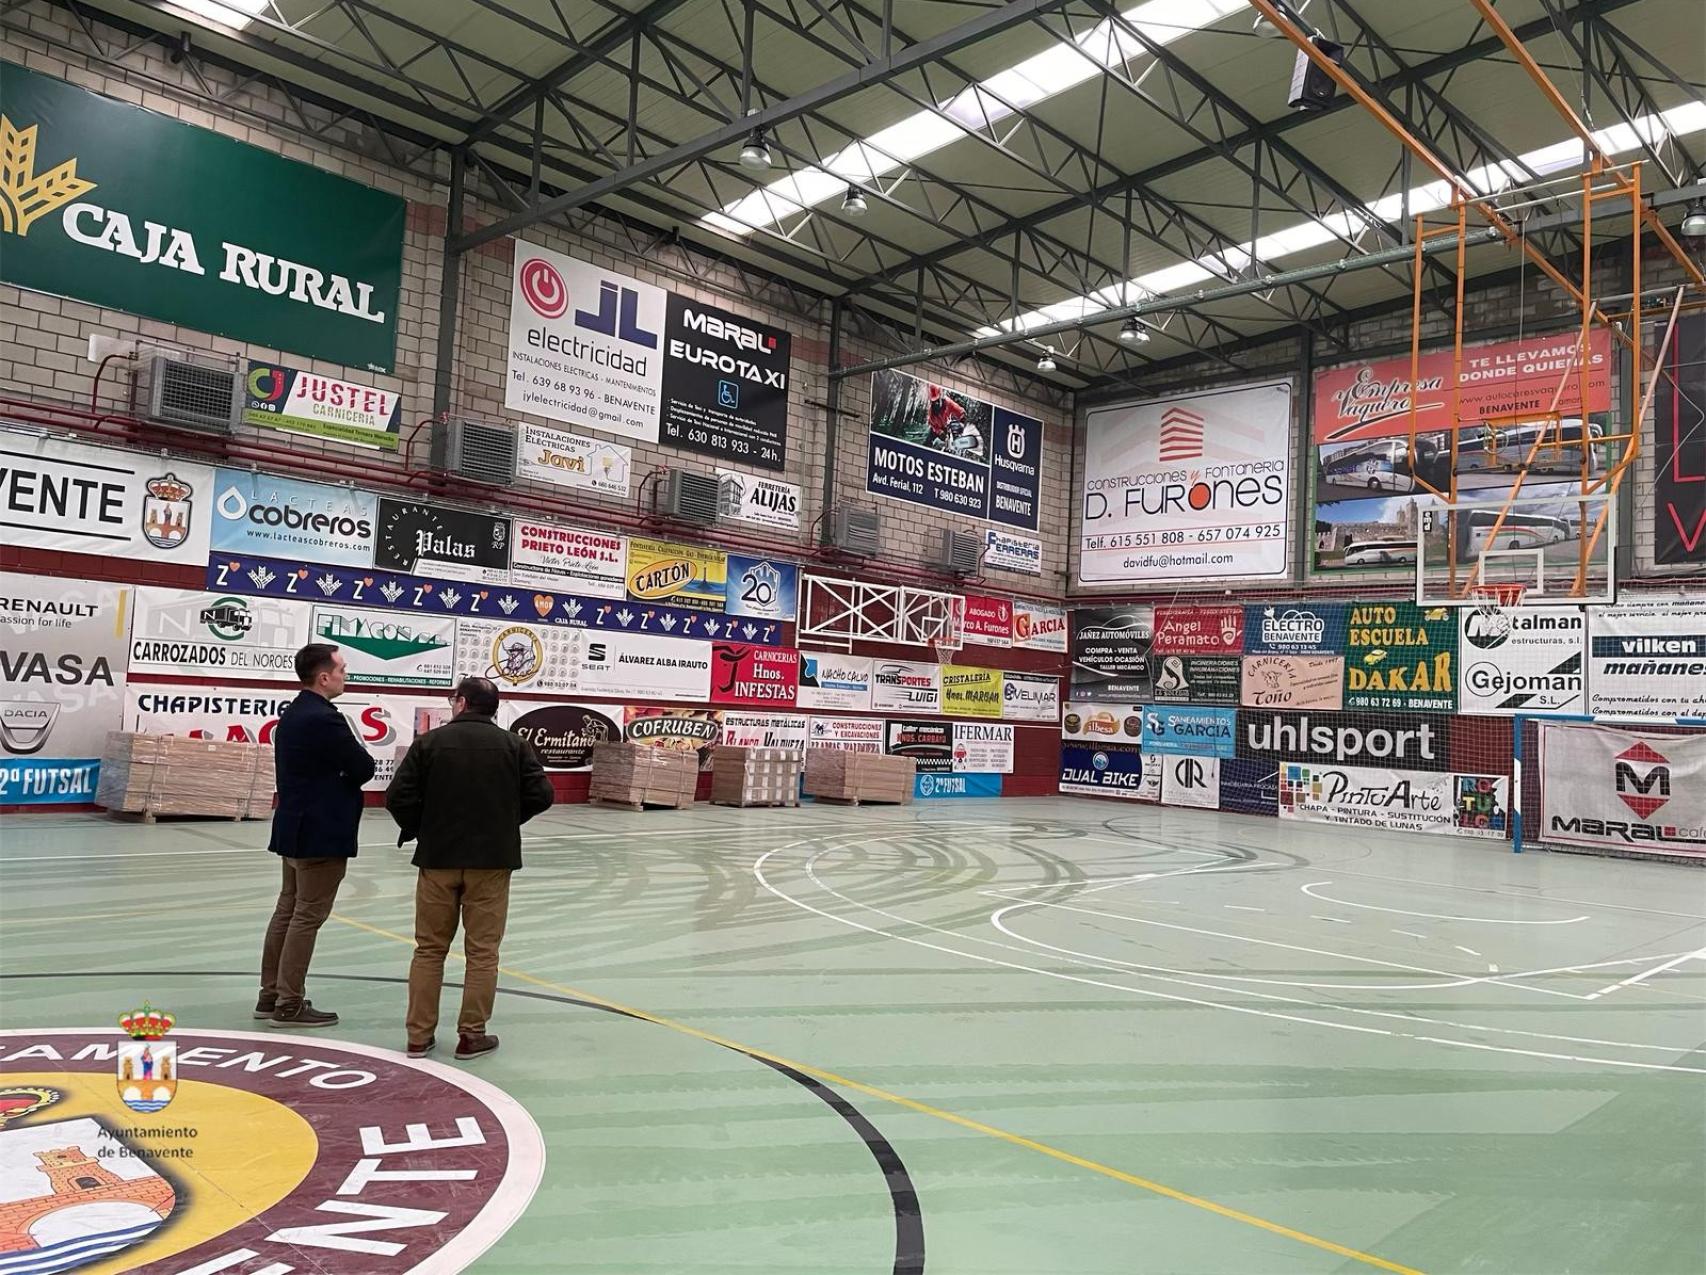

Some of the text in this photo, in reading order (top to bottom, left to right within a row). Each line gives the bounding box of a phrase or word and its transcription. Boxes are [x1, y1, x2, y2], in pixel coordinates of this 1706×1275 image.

[63, 203, 385, 324] CAJA RURAL
[512, 351, 562, 372] INSTALACIONES
[528, 327, 647, 377] electricidad
[670, 339, 786, 390] EUROTAXI
[1469, 357, 1490, 368] TE
[1350, 366, 1444, 403] Emprsa
[1459, 367, 1517, 383] DONDE
[297, 376, 390, 416] JUSTEL
[532, 375, 656, 415] 639 68 93 96 BENAVENTE
[1479, 400, 1541, 415] BENAVENTE
[666, 422, 684, 438] Tel.
[688, 428, 708, 444] 630
[711, 434, 727, 449] 813
[731, 439, 749, 454] 933
[538, 449, 585, 473] Javi
[874, 446, 924, 478] MOTOS
[872, 472, 889, 486] Avd.
[912, 482, 924, 495] 112
[927, 461, 985, 494] ESTEBAN
[750, 488, 797, 512] ALIJAS
[969, 496, 982, 509] 923
[995, 494, 1032, 516] BENAVENTE
[1085, 493, 1113, 520] D.
[249, 504, 372, 539] cobreros
[246, 529, 371, 552] www.lacteascobreros.com
[415, 529, 476, 559] Palas
[521, 526, 622, 551] CONSTRUCCIONES
[1086, 524, 1280, 550] Telf. 615 551 808 657 074 925
[521, 539, 564, 554] PRIETO
[566, 545, 597, 559] LEÓN
[1123, 552, 1234, 569] davidfu@hotmail.com
[635, 561, 691, 592] CARTÓN
[741, 573, 772, 604] 20
[38, 616, 72, 629] for life
[953, 617, 975, 630] Mrco
[1163, 615, 1201, 635] Ángel
[1263, 619, 1323, 632] ELECTRO
[1350, 607, 1396, 625] AUTO
[1078, 629, 1150, 641] JAÑEZ AUTOMÓVILES
[1156, 631, 1220, 646] Peramato
[1264, 632, 1320, 641] BENAVENTE
[1350, 628, 1429, 646] ESCUELA
[133, 641, 248, 667] CARROZADOS DEL
[1622, 639, 1697, 653] vilken
[618, 651, 708, 670] ÁLVAREZ ALBA IRAUTO
[753, 650, 797, 664] CARNICERIAS
[1079, 655, 1113, 663] VEHÍCULOS
[581, 663, 611, 671] SEAT
[752, 662, 785, 680] Hnos.
[1349, 651, 1453, 692] DAKAR
[875, 673, 932, 687] TRANSPORTES
[1472, 670, 1581, 694] Gejoman
[735, 681, 796, 701] INFESTAS
[908, 691, 938, 704] LUIGI
[1252, 689, 1293, 705] Toño
[1539, 695, 1560, 705] S.L.
[1592, 693, 1659, 705] Comprometidos
[1355, 697, 1453, 709] 980 63 72 69 BENAVENTE
[1592, 706, 1659, 716] Comprometidos
[1680, 708, 1689, 717] el
[4, 708, 48, 719] DACIA
[725, 717, 806, 729] ESTRUCTURAS METÁLICAS
[1168, 715, 1232, 727] SANEAMIENTOS
[632, 719, 715, 739] COFRUBEN
[832, 722, 882, 731] CONSTRUCCIONES
[840, 731, 880, 739] EXCAVACIONES
[954, 724, 1012, 742] IFERMAR
[1087, 722, 1115, 735] ilbesa
[1248, 715, 1435, 762] uhlsport
[22, 767, 93, 795] FUTSAL
[1062, 768, 1140, 787] DUAL BIKE
[1615, 761, 1671, 796] M
[1300, 804, 1451, 824] CHAPA PINTURA SUSTITUCIÓN
[1334, 816, 1424, 832] TINTADO DE LUNAS
